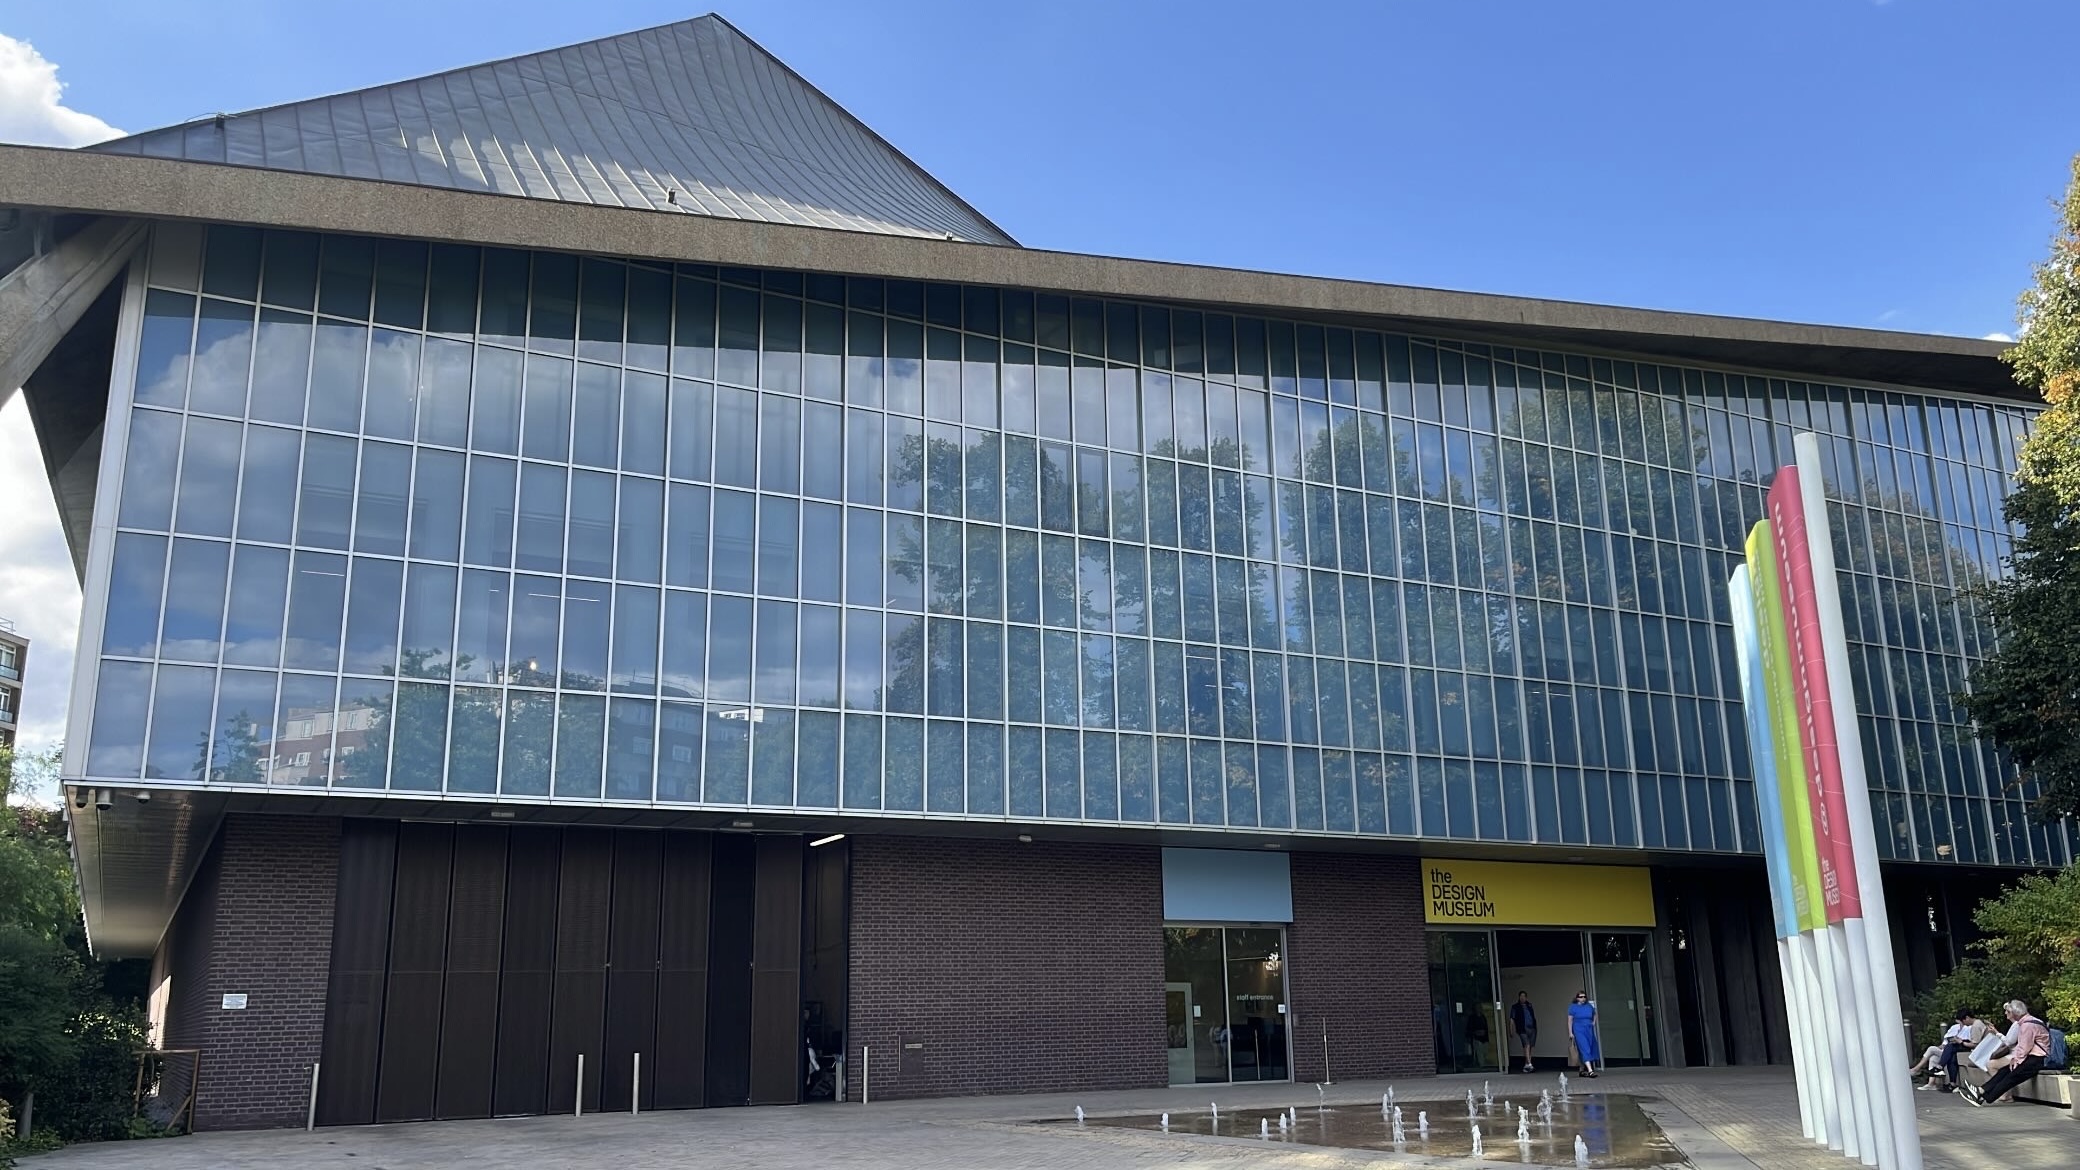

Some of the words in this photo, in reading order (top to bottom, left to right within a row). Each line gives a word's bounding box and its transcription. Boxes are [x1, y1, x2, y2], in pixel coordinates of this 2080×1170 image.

[1774, 502, 1829, 836] @designmuseum
[1431, 868, 1451, 883] the
[1824, 870, 1838, 890] DESIG
[1432, 884, 1485, 900] DESIGN
[1433, 901, 1494, 917] MUSEUM
